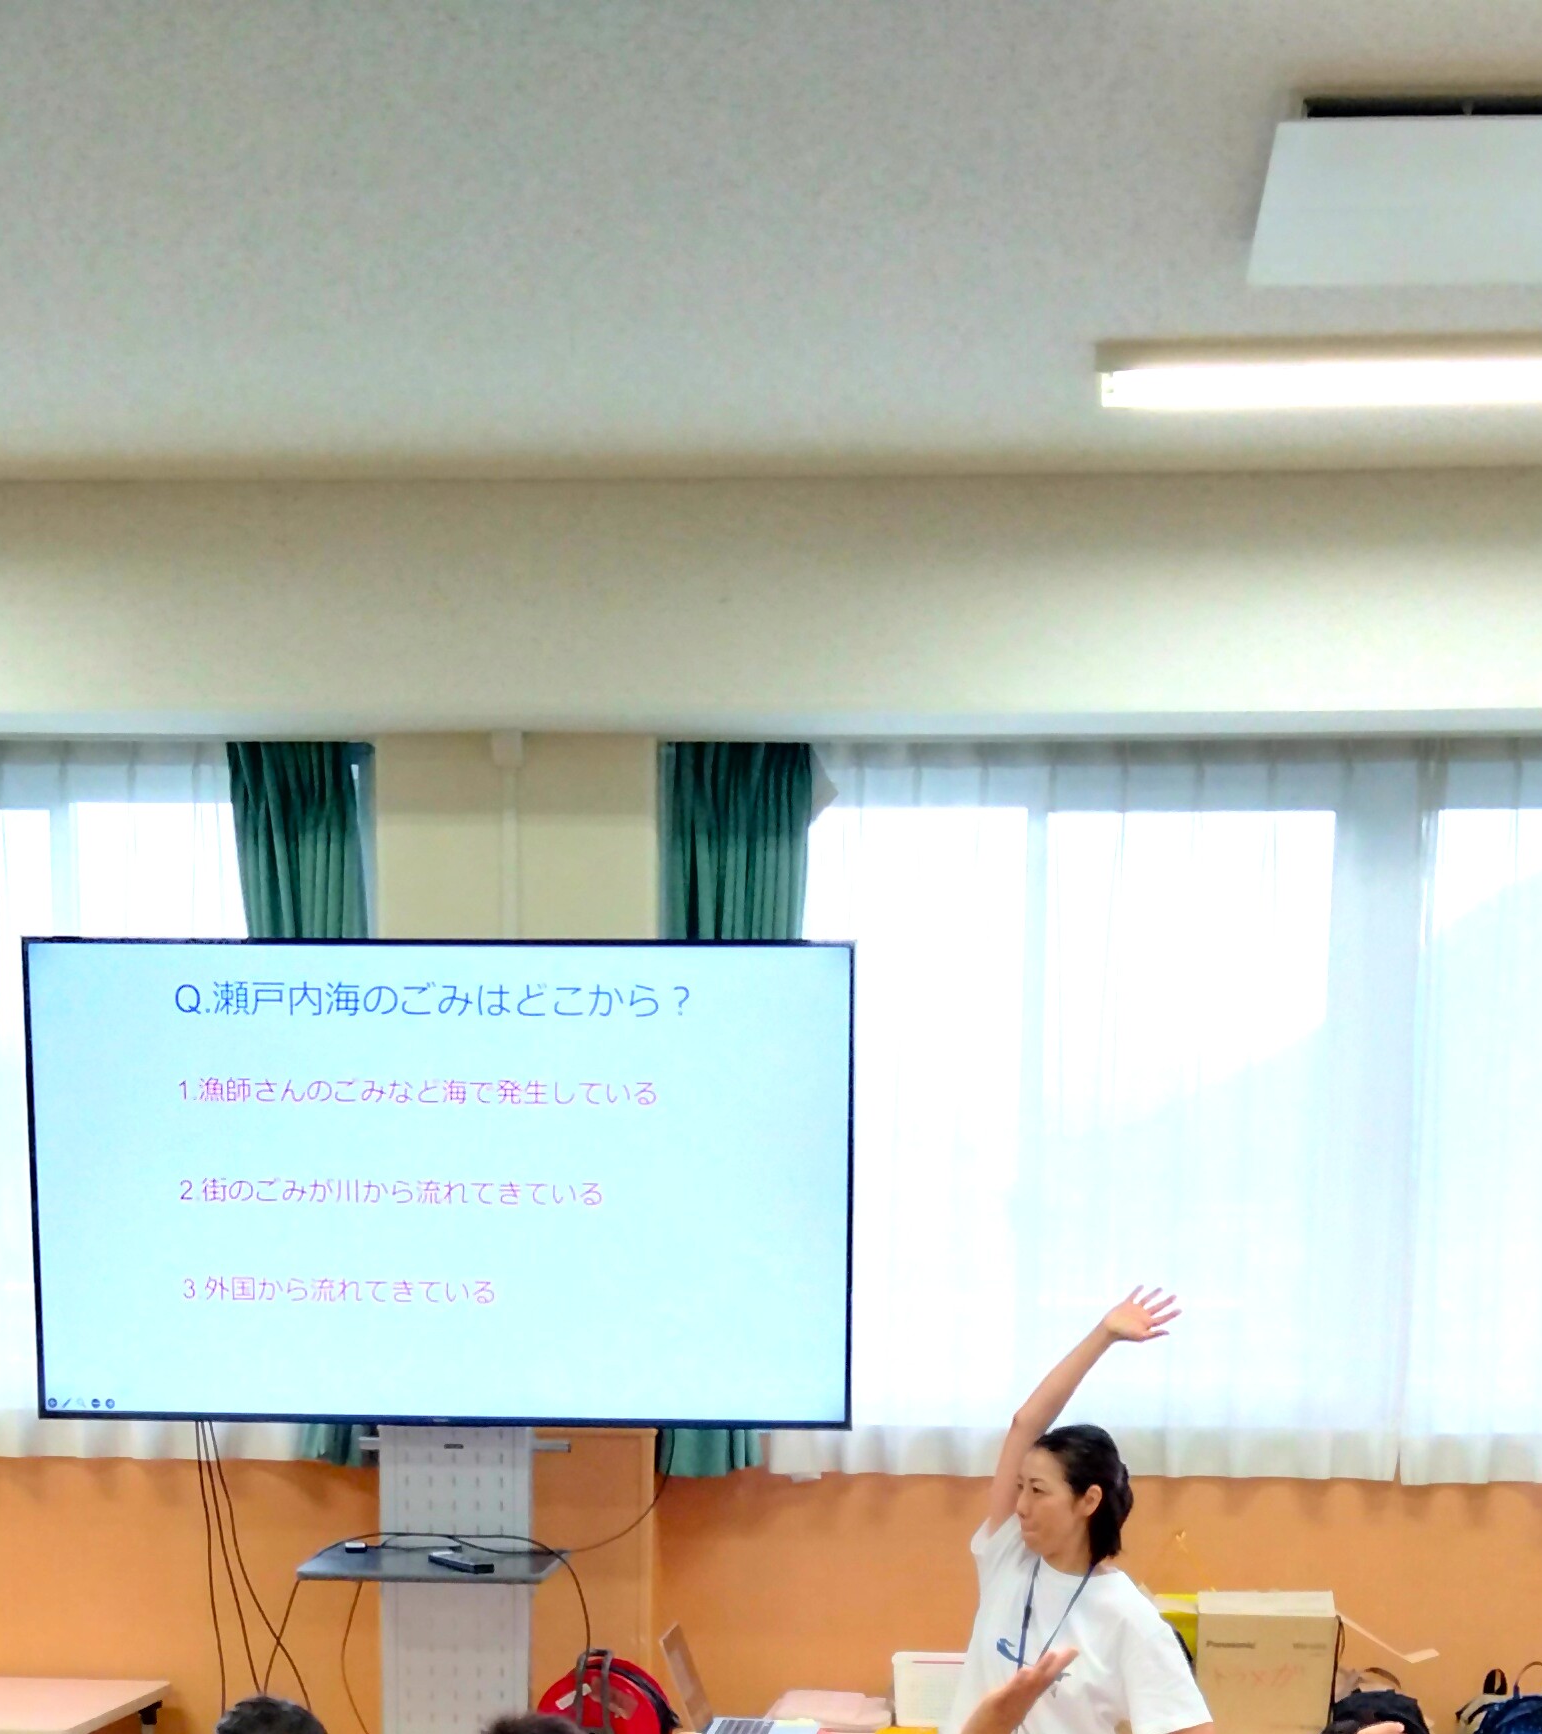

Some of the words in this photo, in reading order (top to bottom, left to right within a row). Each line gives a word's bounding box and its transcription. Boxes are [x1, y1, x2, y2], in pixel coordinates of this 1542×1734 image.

[174, 980, 692, 1019] Q.瀬戸内海のごみはどこから？
